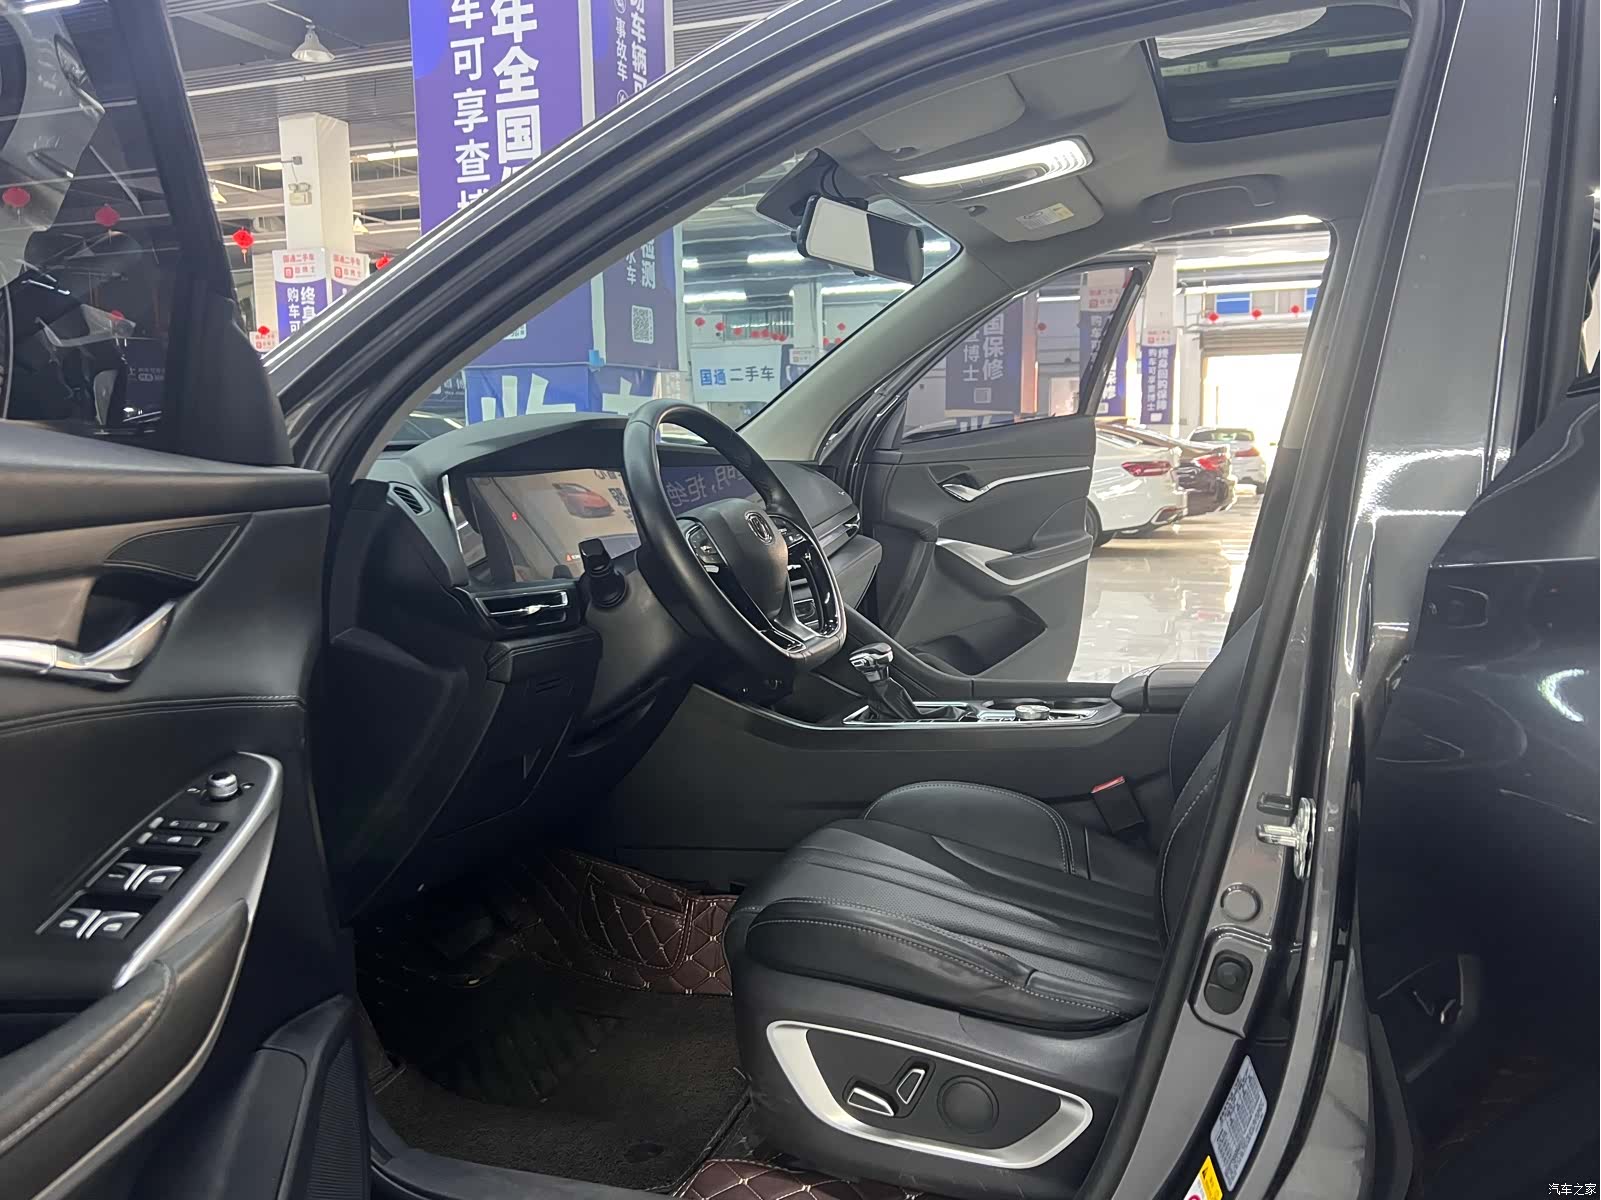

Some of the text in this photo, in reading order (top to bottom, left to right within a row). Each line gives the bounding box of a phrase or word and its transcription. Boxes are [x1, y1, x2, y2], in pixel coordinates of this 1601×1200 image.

[490, 0, 543, 183] 年全国
[699, 365, 776, 387] 国通二手车
